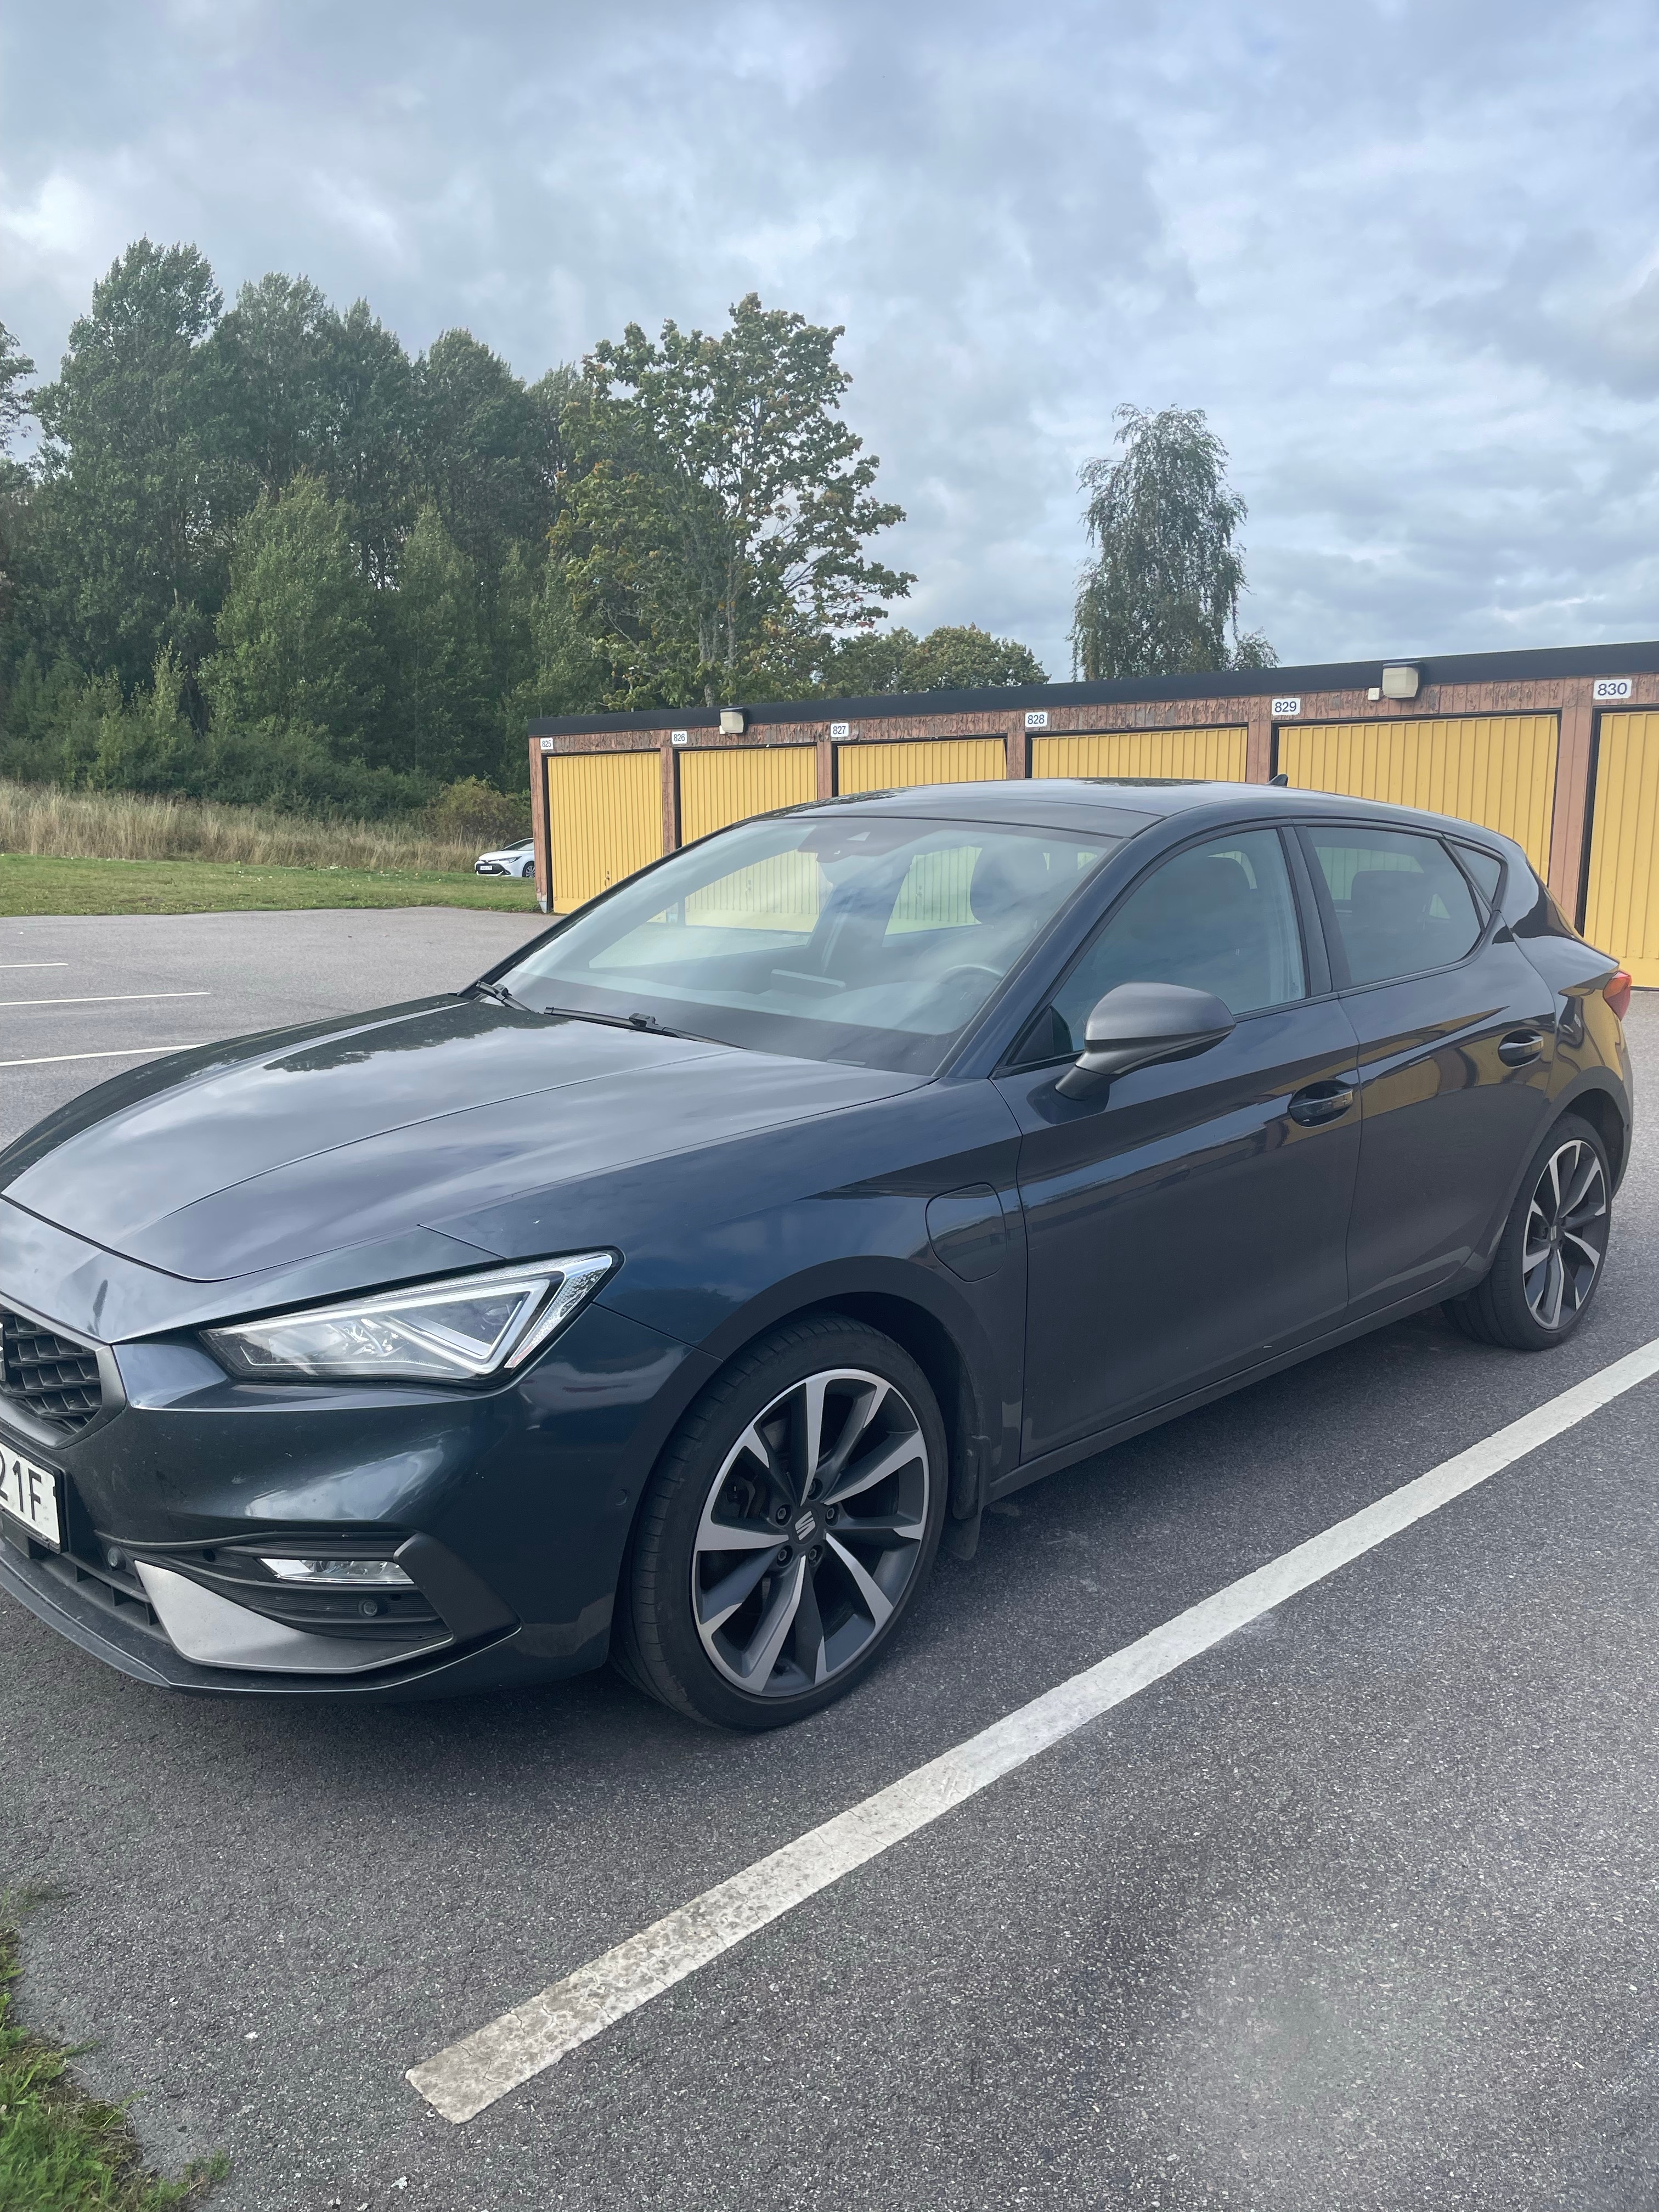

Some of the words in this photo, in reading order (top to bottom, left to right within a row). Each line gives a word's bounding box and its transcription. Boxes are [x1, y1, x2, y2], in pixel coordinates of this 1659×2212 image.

[1597, 682, 1628, 696] 830
[1274, 701, 1297, 713] 829
[1027, 714, 1045, 725] 828
[833, 725, 847, 735] 827
[673, 733, 685, 742] 826
[541, 740, 551, 748] 825
